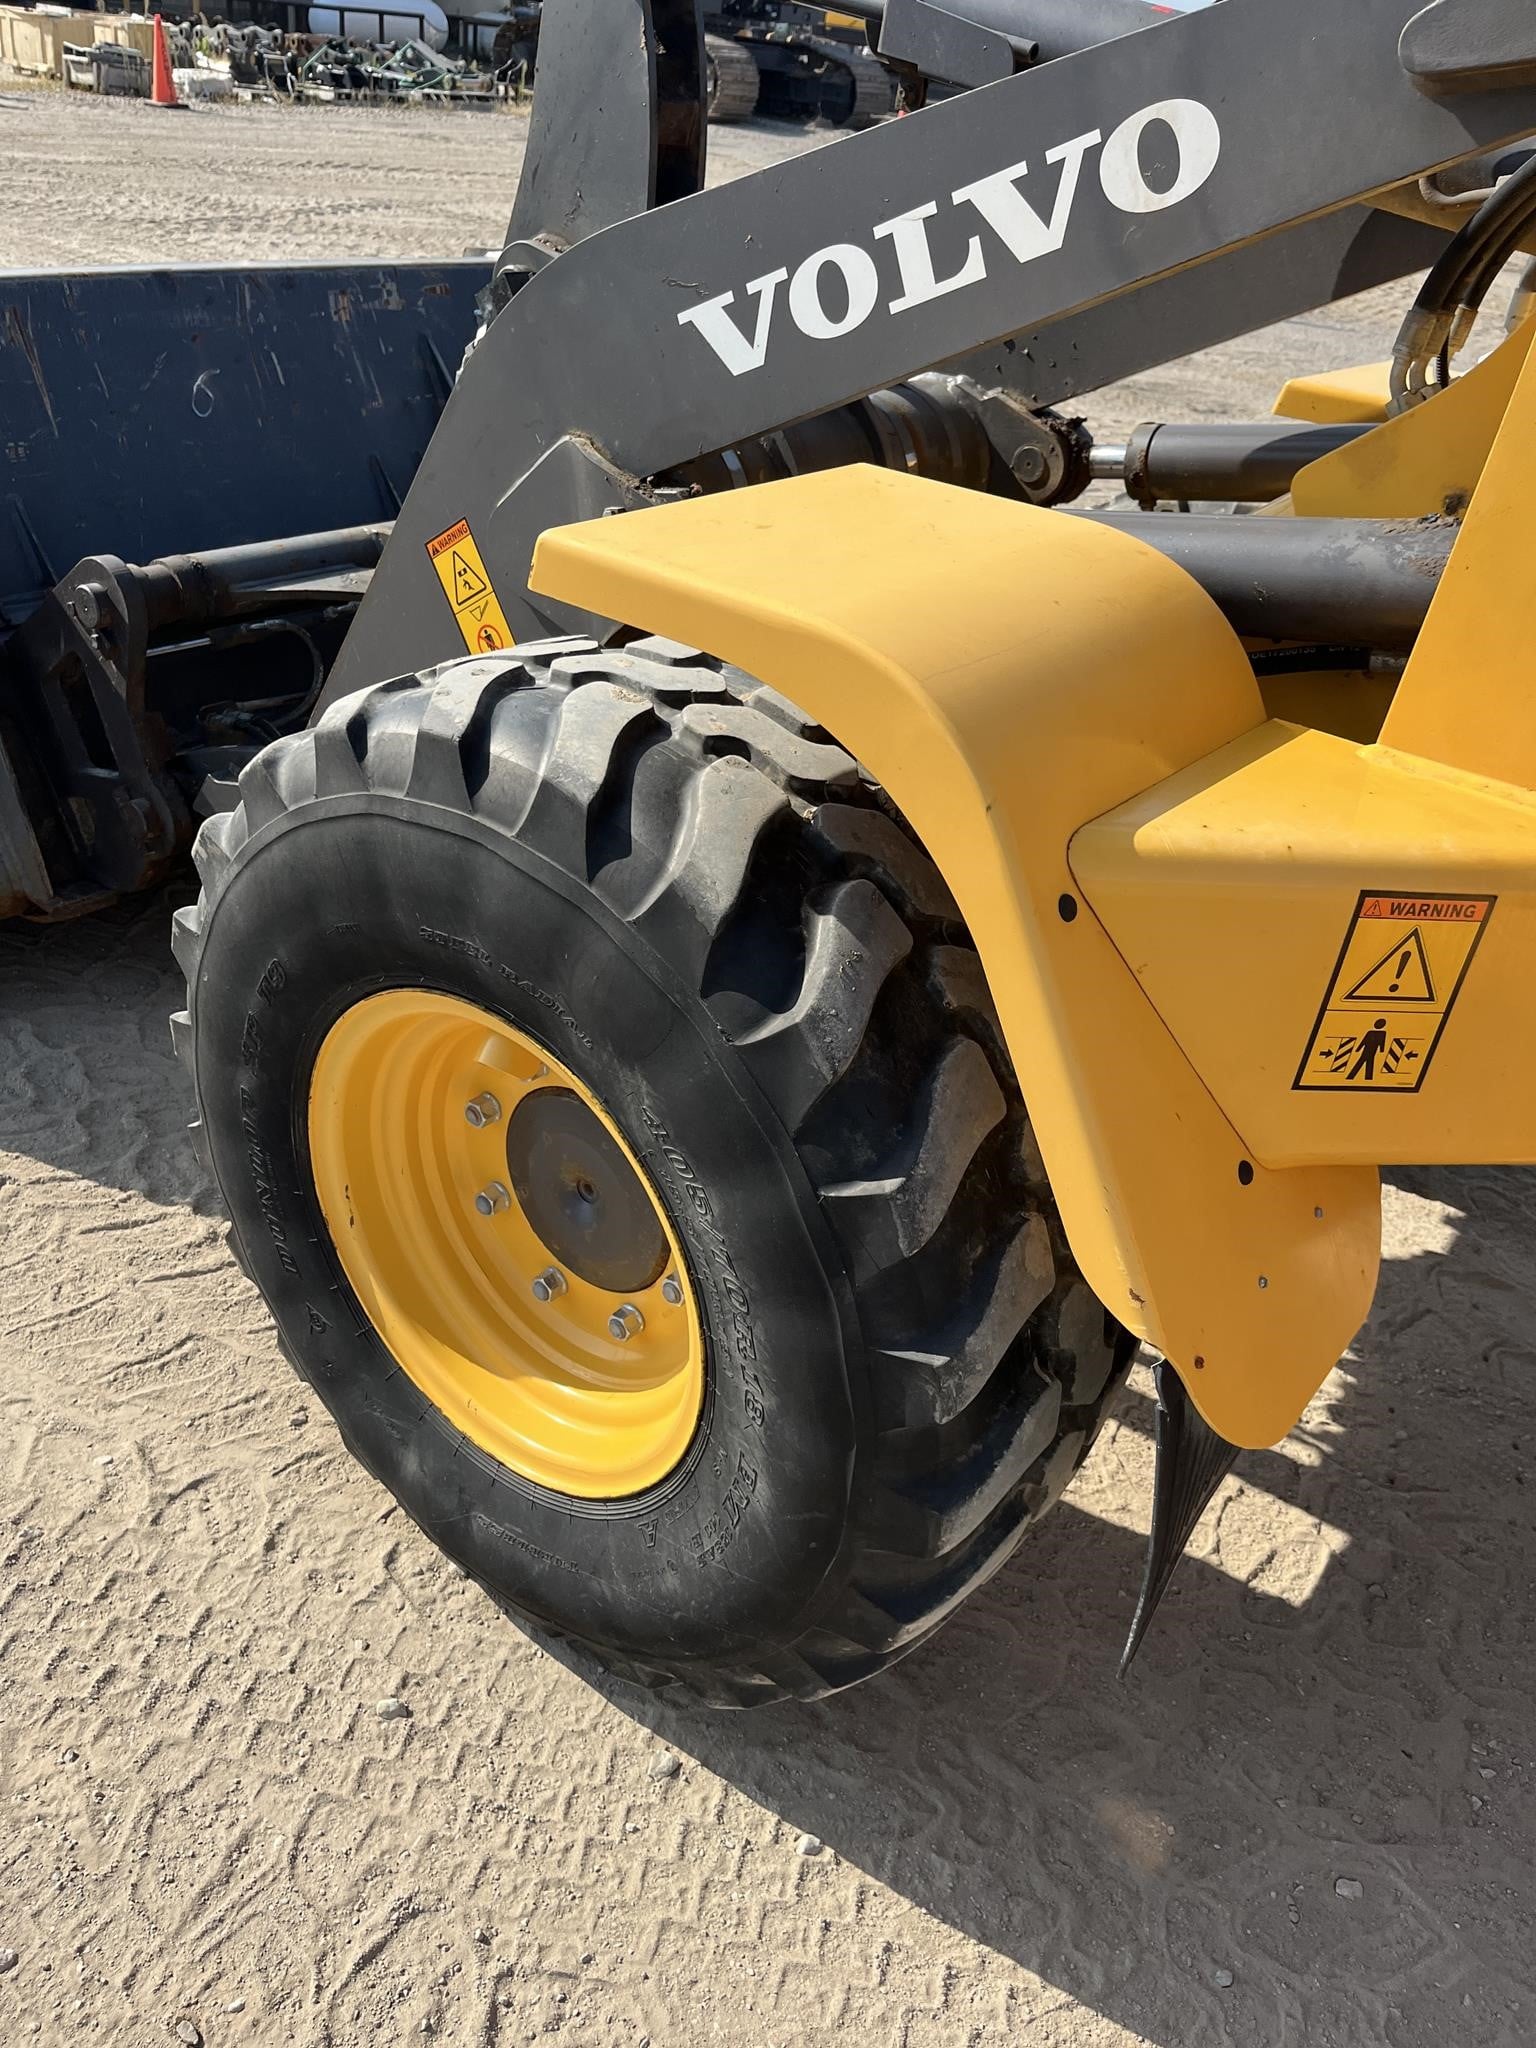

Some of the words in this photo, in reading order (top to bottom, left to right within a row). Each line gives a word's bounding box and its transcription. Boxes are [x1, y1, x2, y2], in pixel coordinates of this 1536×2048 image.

[677, 98, 1220, 376] VOLVO
[438, 523, 468, 549] WARNING
[1389, 902, 1477, 918] WARNING
[419, 925, 492, 967] STEEL
[498, 963, 594, 1049] RADIAL
[722, 1451, 757, 1529] EM
